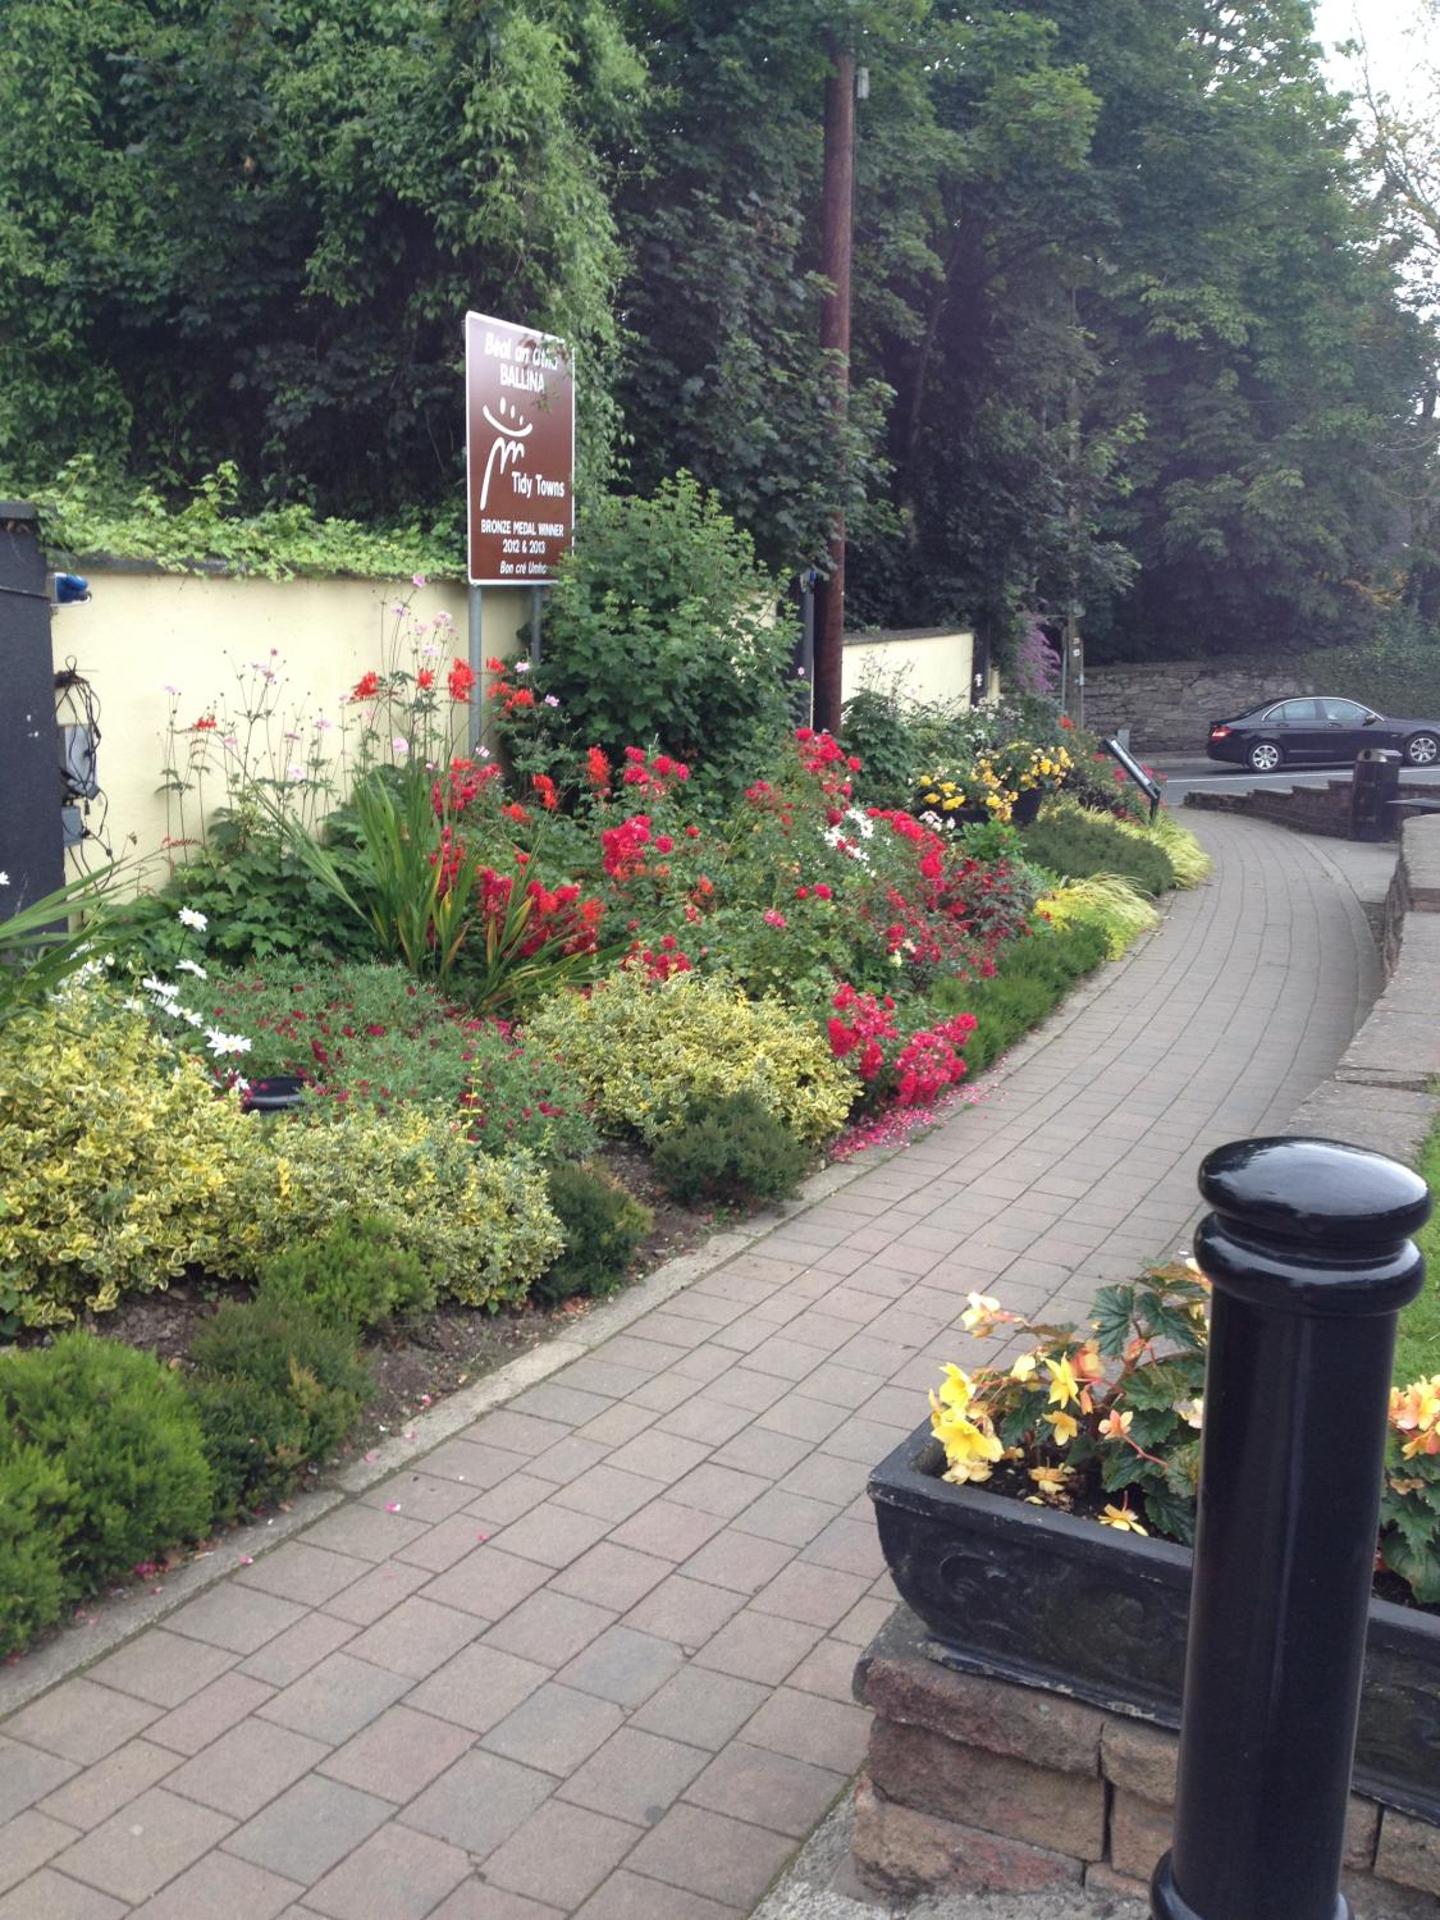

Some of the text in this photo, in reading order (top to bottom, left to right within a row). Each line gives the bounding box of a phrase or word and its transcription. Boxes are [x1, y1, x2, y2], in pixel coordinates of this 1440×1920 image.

[500, 363, 545, 392] BALLINA
[512, 471, 565, 499] Tidy Towns
[481, 518, 564, 537] BRONZE MEDAL WINNER
[502, 538, 546, 554] 2012 & 2013
